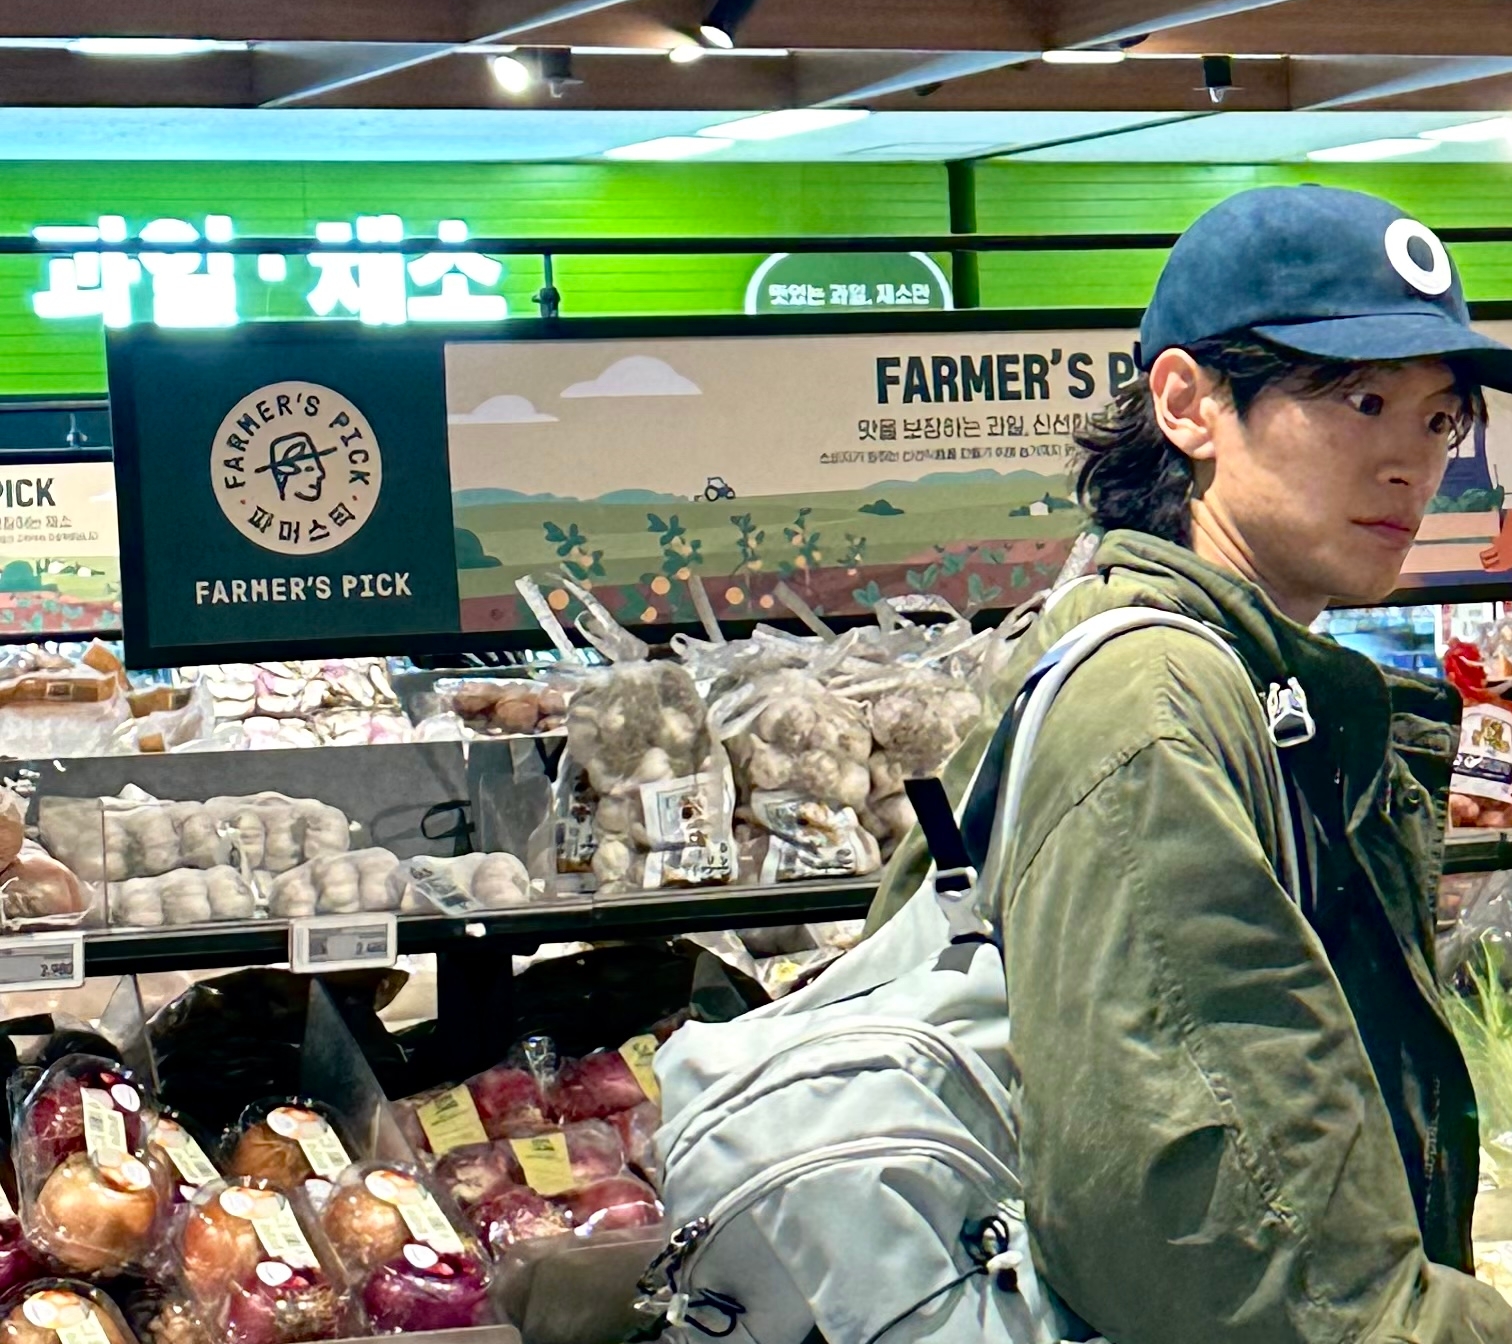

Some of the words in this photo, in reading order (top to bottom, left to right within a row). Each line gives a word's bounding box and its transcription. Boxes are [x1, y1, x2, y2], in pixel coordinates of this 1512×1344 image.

[876, 349, 1096, 404] FARMER'S
[329, 411, 371, 486] PICK
[0, 477, 56, 508] ICK
[195, 575, 332, 605] FARMER'S
[341, 571, 412, 599] PICK
